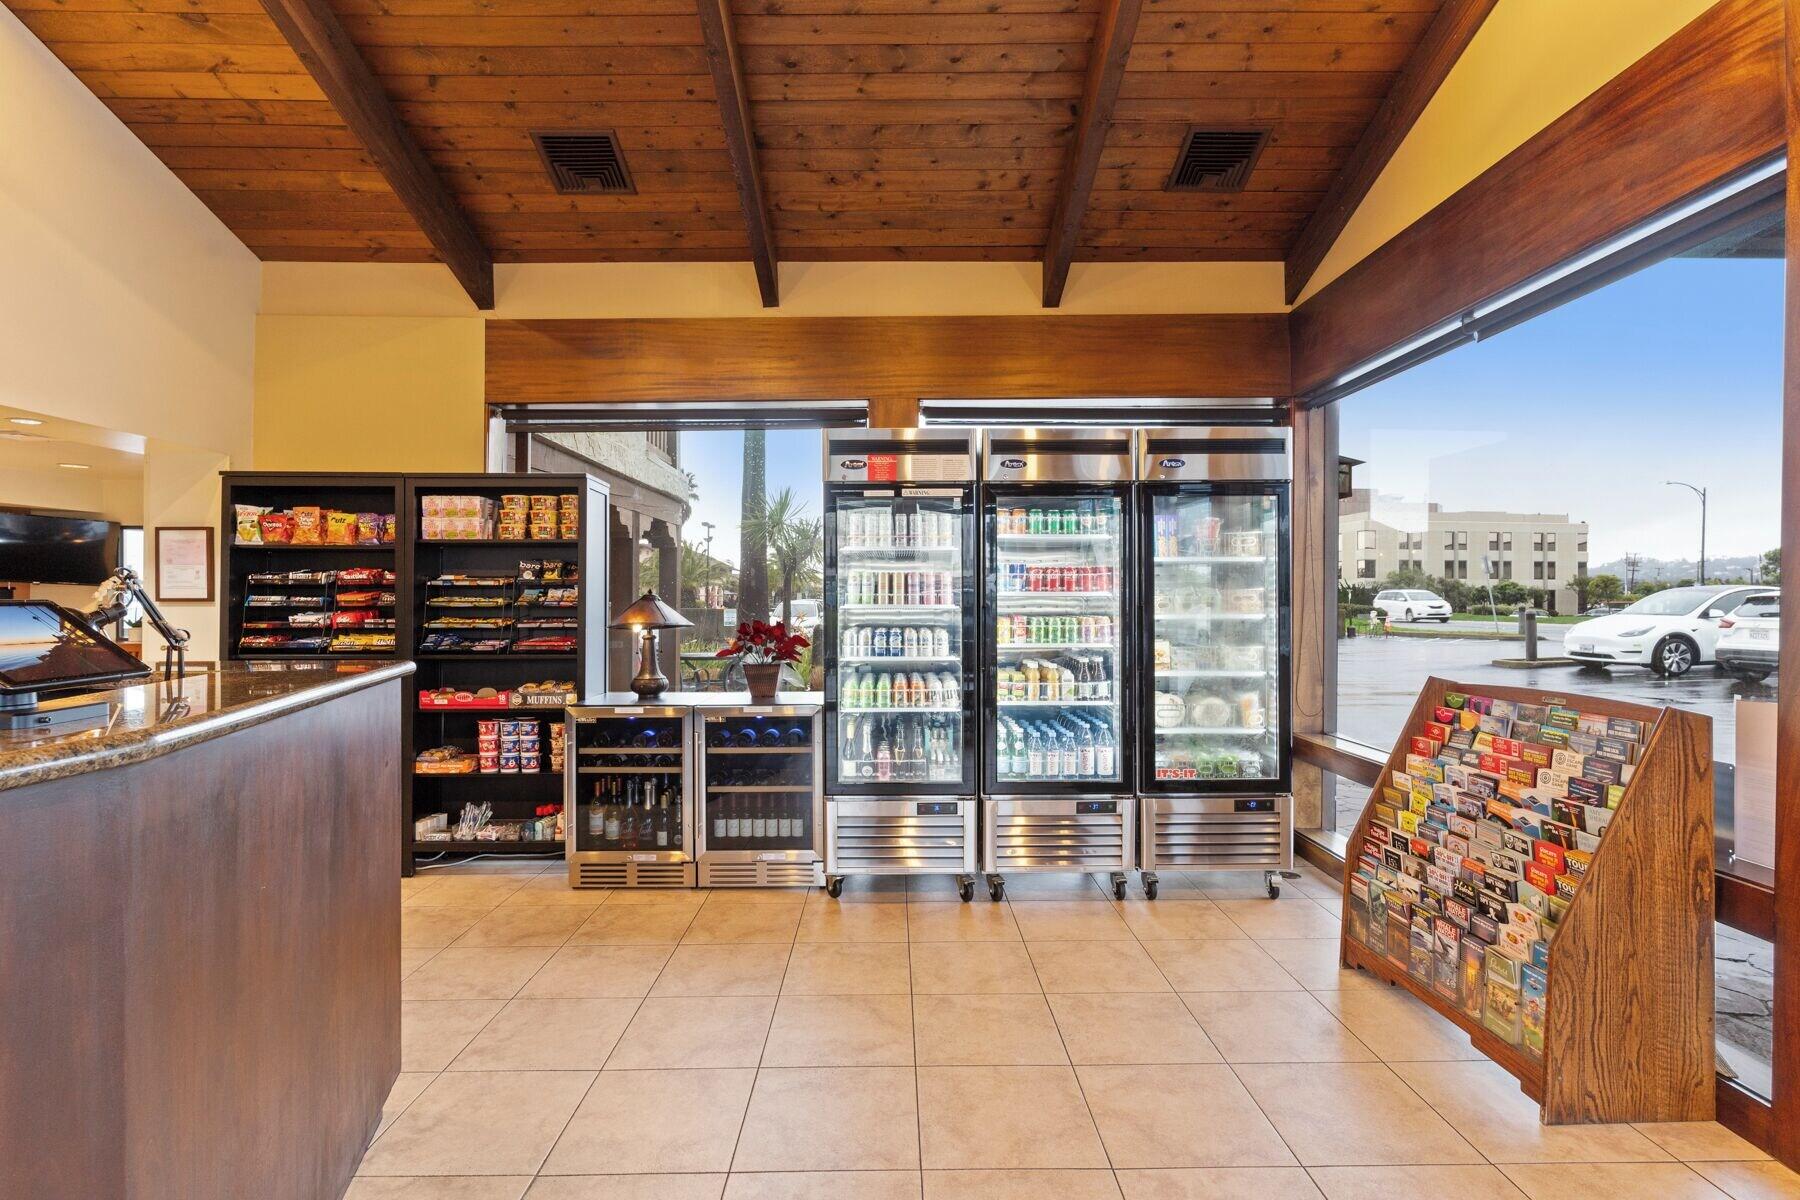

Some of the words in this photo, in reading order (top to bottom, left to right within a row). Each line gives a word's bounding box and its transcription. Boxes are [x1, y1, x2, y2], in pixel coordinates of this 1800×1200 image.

[519, 560, 541, 570] bare
[526, 695, 563, 704] MUFFINS
[1156, 768, 1197, 779] IT'S-IT
[1567, 858, 1588, 870] TOU
